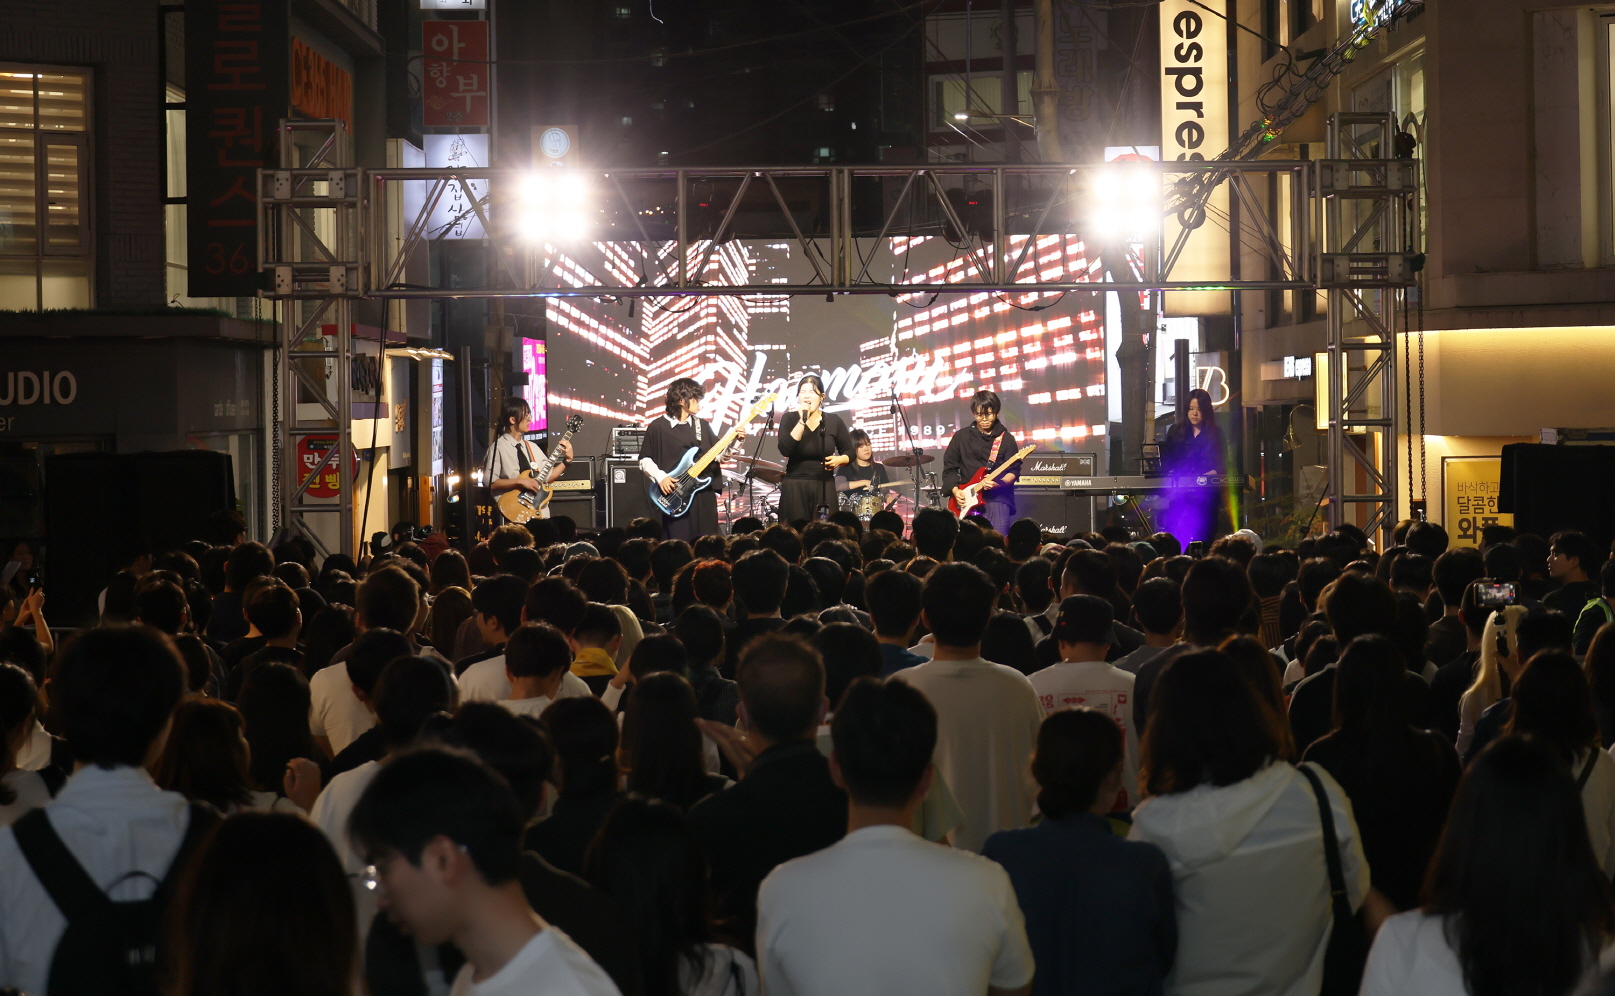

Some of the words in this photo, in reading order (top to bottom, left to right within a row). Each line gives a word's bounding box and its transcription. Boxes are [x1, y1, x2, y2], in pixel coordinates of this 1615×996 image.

[1458, 481, 1500, 494] 바삭하고
[1457, 496, 1499, 514] 달콤한
[1039, 524, 1068, 534] arshall
